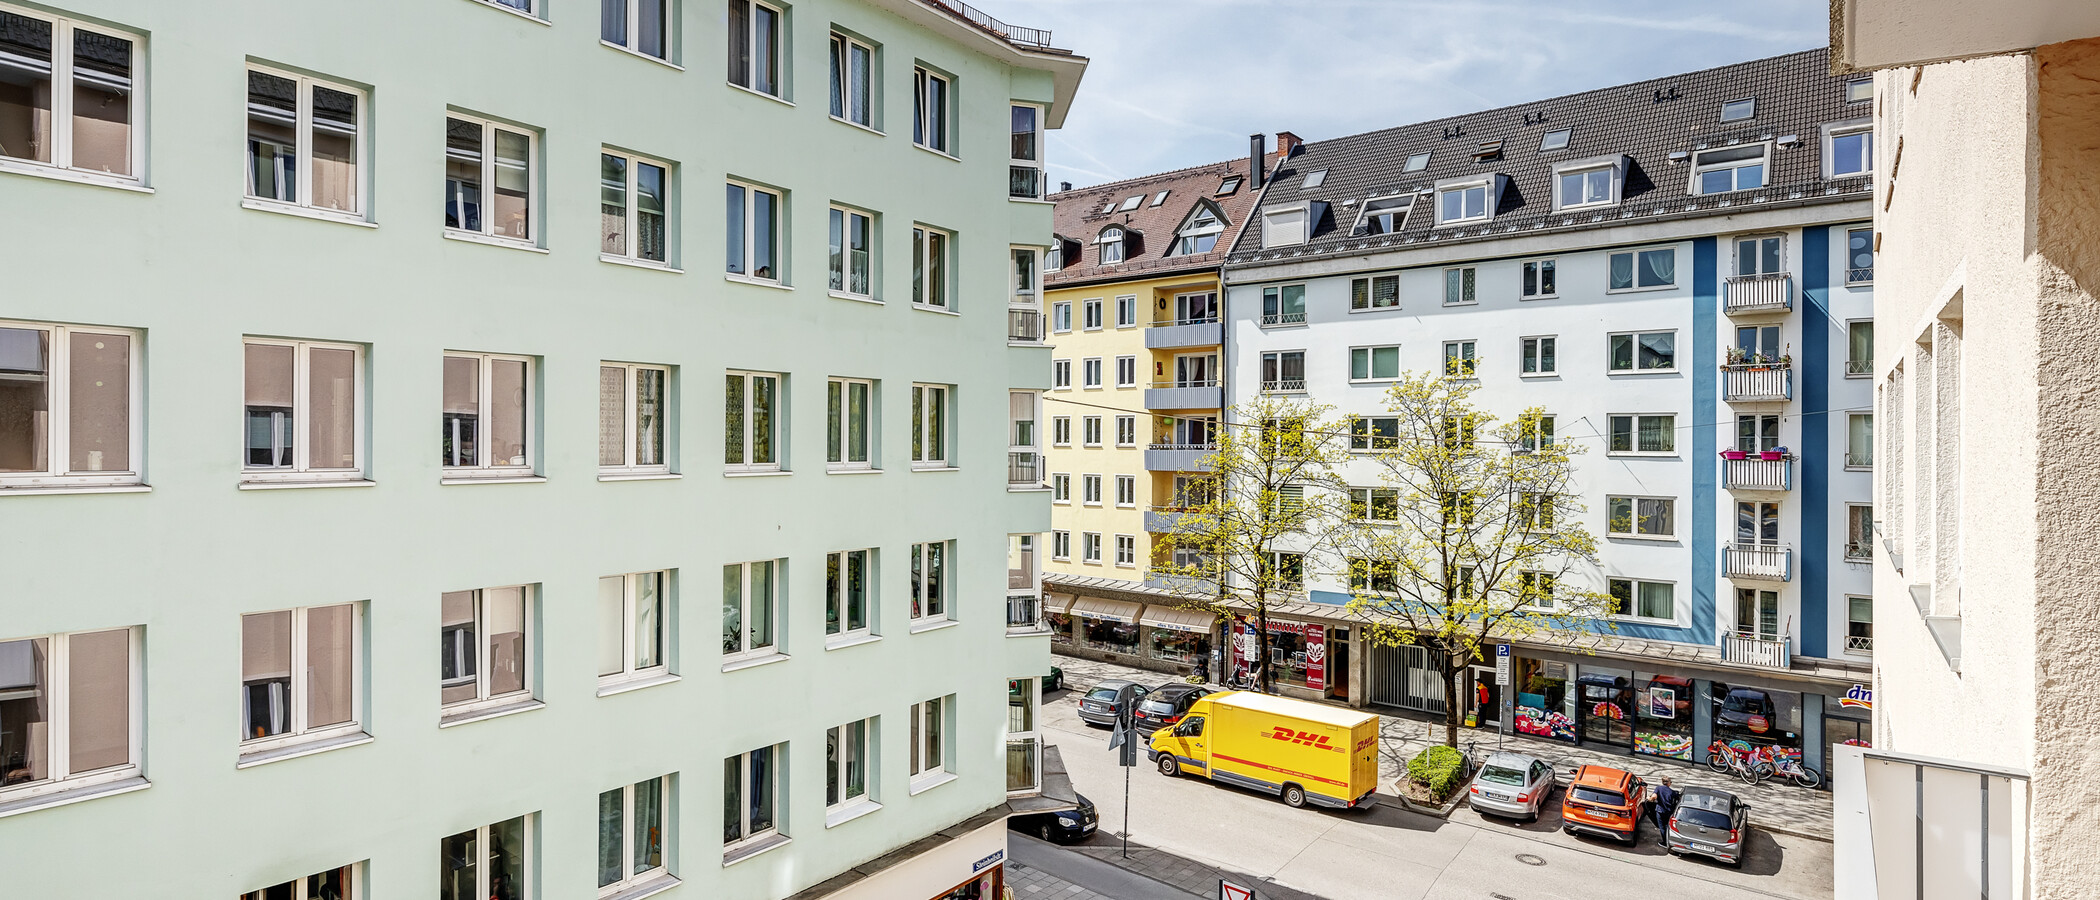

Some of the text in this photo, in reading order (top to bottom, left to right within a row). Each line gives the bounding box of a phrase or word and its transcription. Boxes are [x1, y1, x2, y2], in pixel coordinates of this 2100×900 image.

[1498, 646, 1507, 655] P
[1272, 726, 1334, 751] DHL
[1357, 736, 1375, 752] DHL
